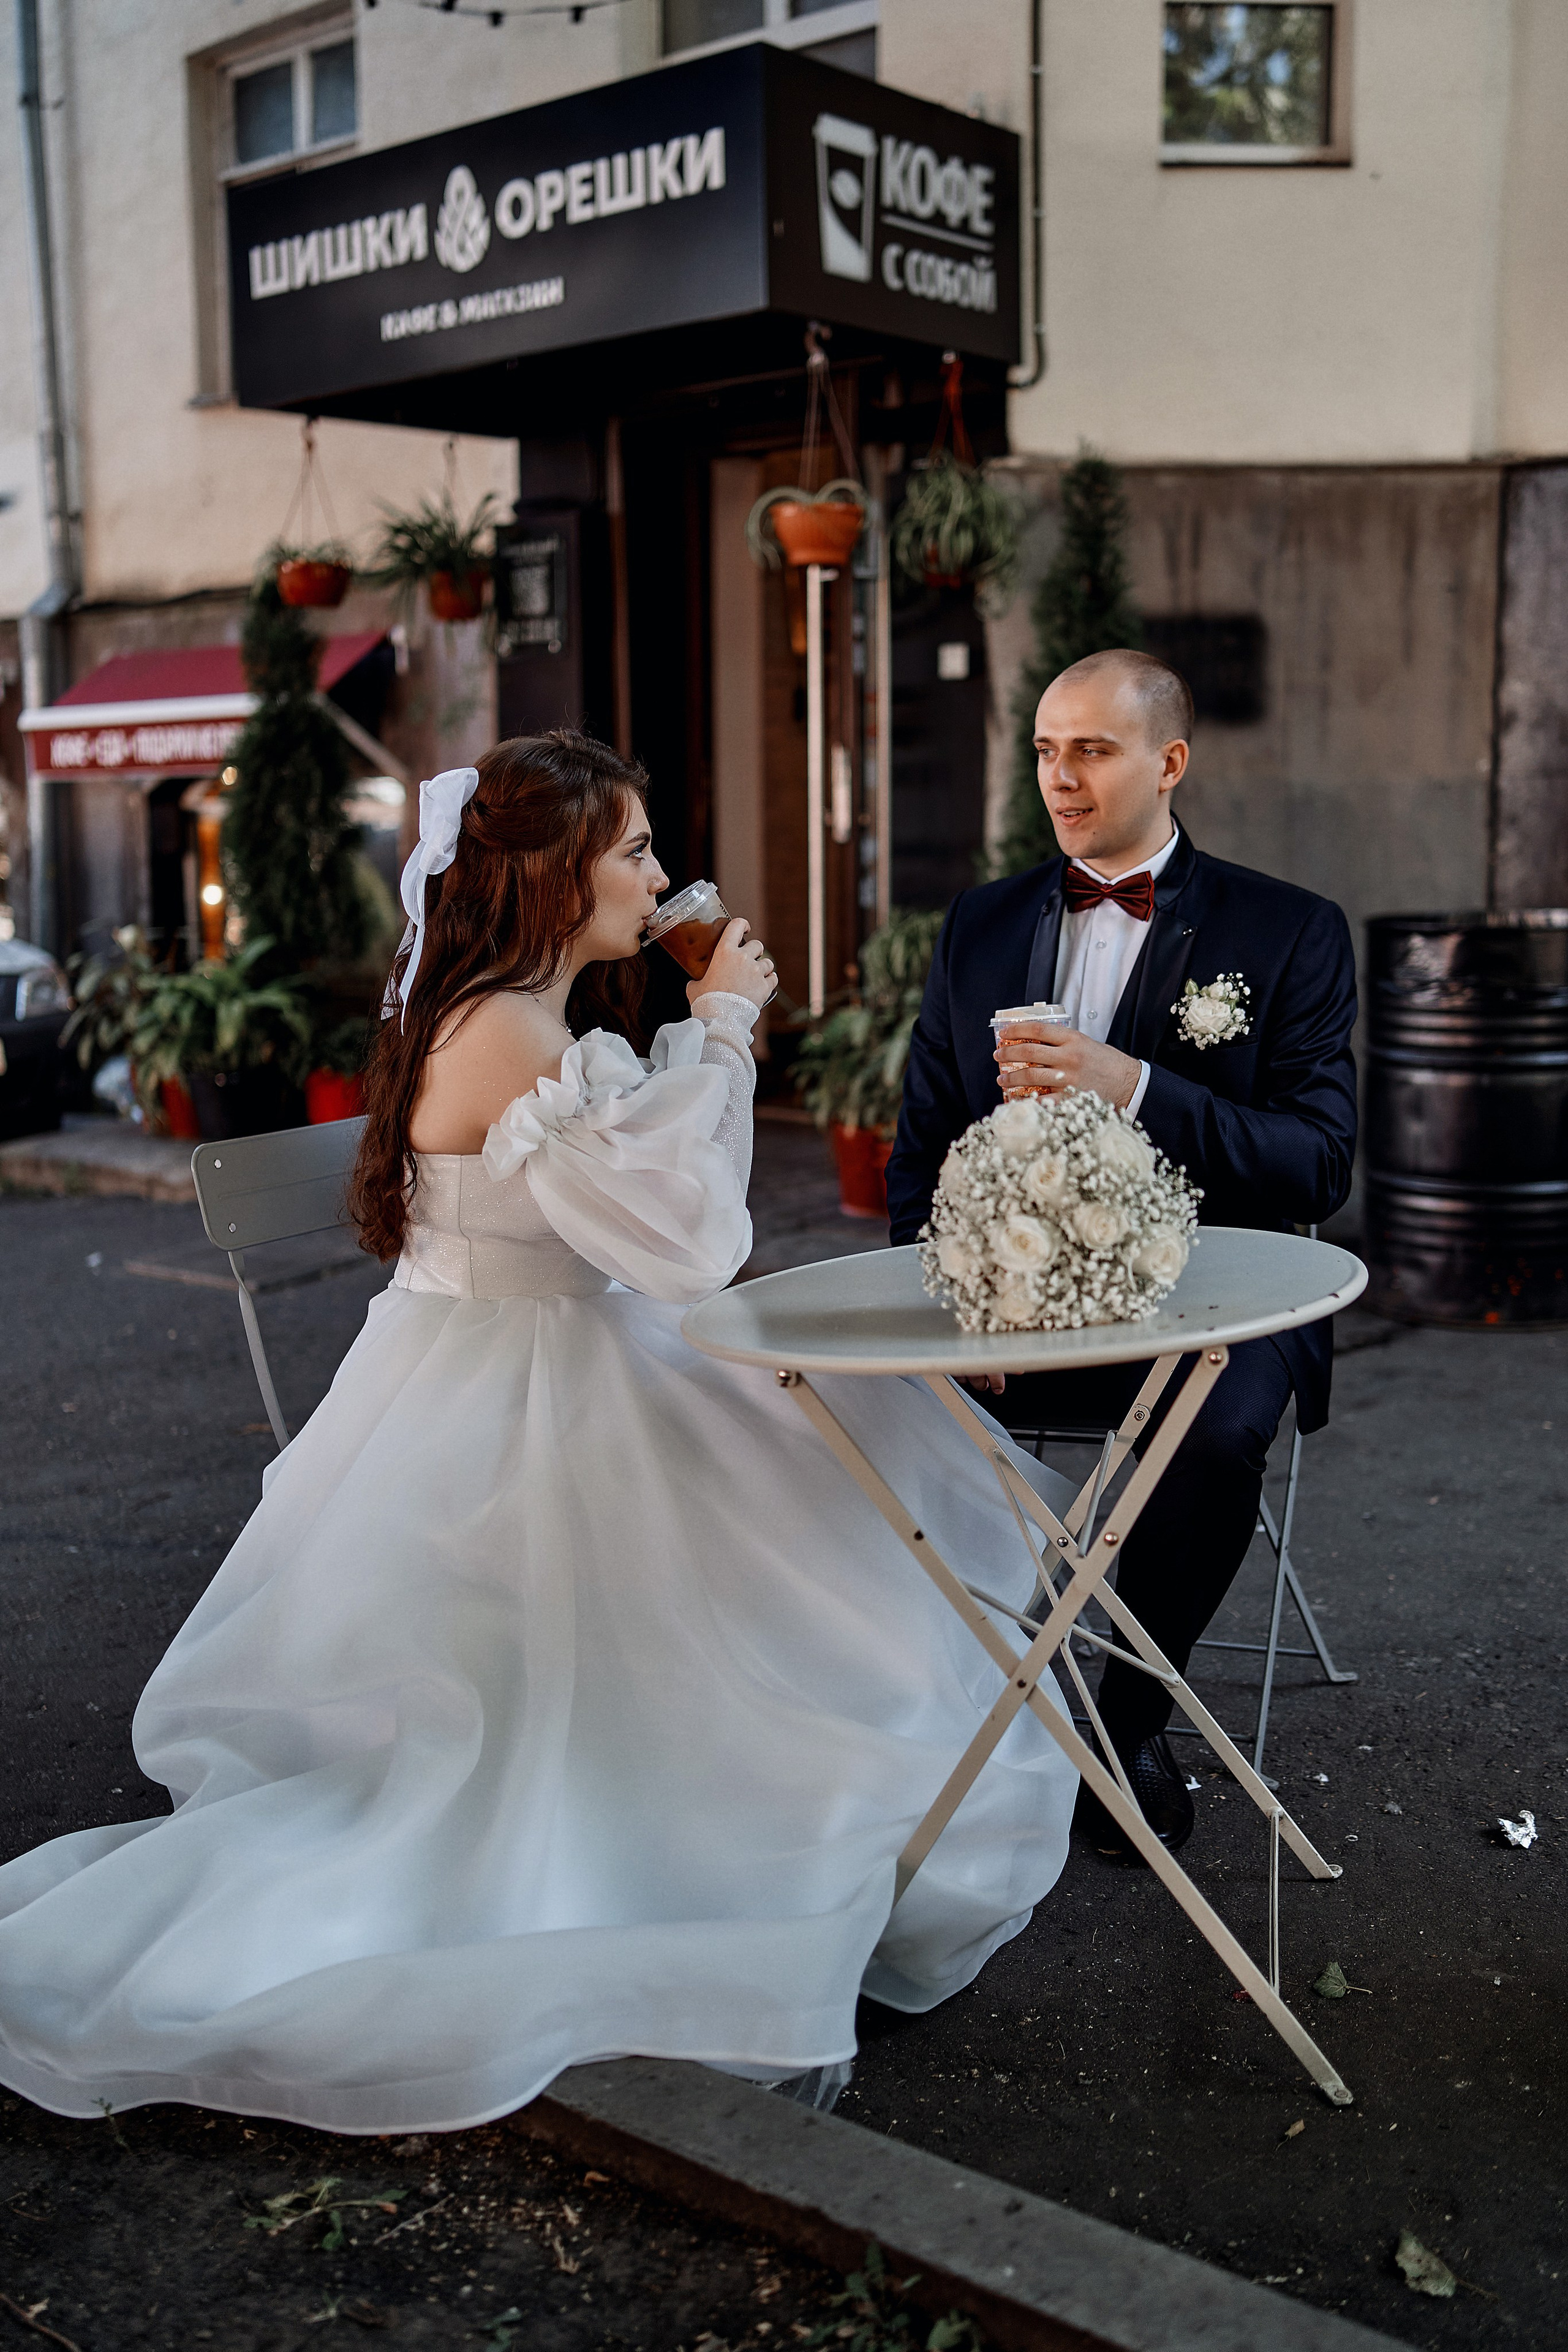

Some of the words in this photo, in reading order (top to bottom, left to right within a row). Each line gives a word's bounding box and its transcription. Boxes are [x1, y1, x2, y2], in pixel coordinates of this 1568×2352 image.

[248, 203, 429, 300] ШИШКИ
[494, 126, 727, 239] ОРЕШКИ
[880, 135, 995, 235] КОФЕ
[881, 244, 903, 290] С
[904, 249, 998, 314] СОБОЙ
